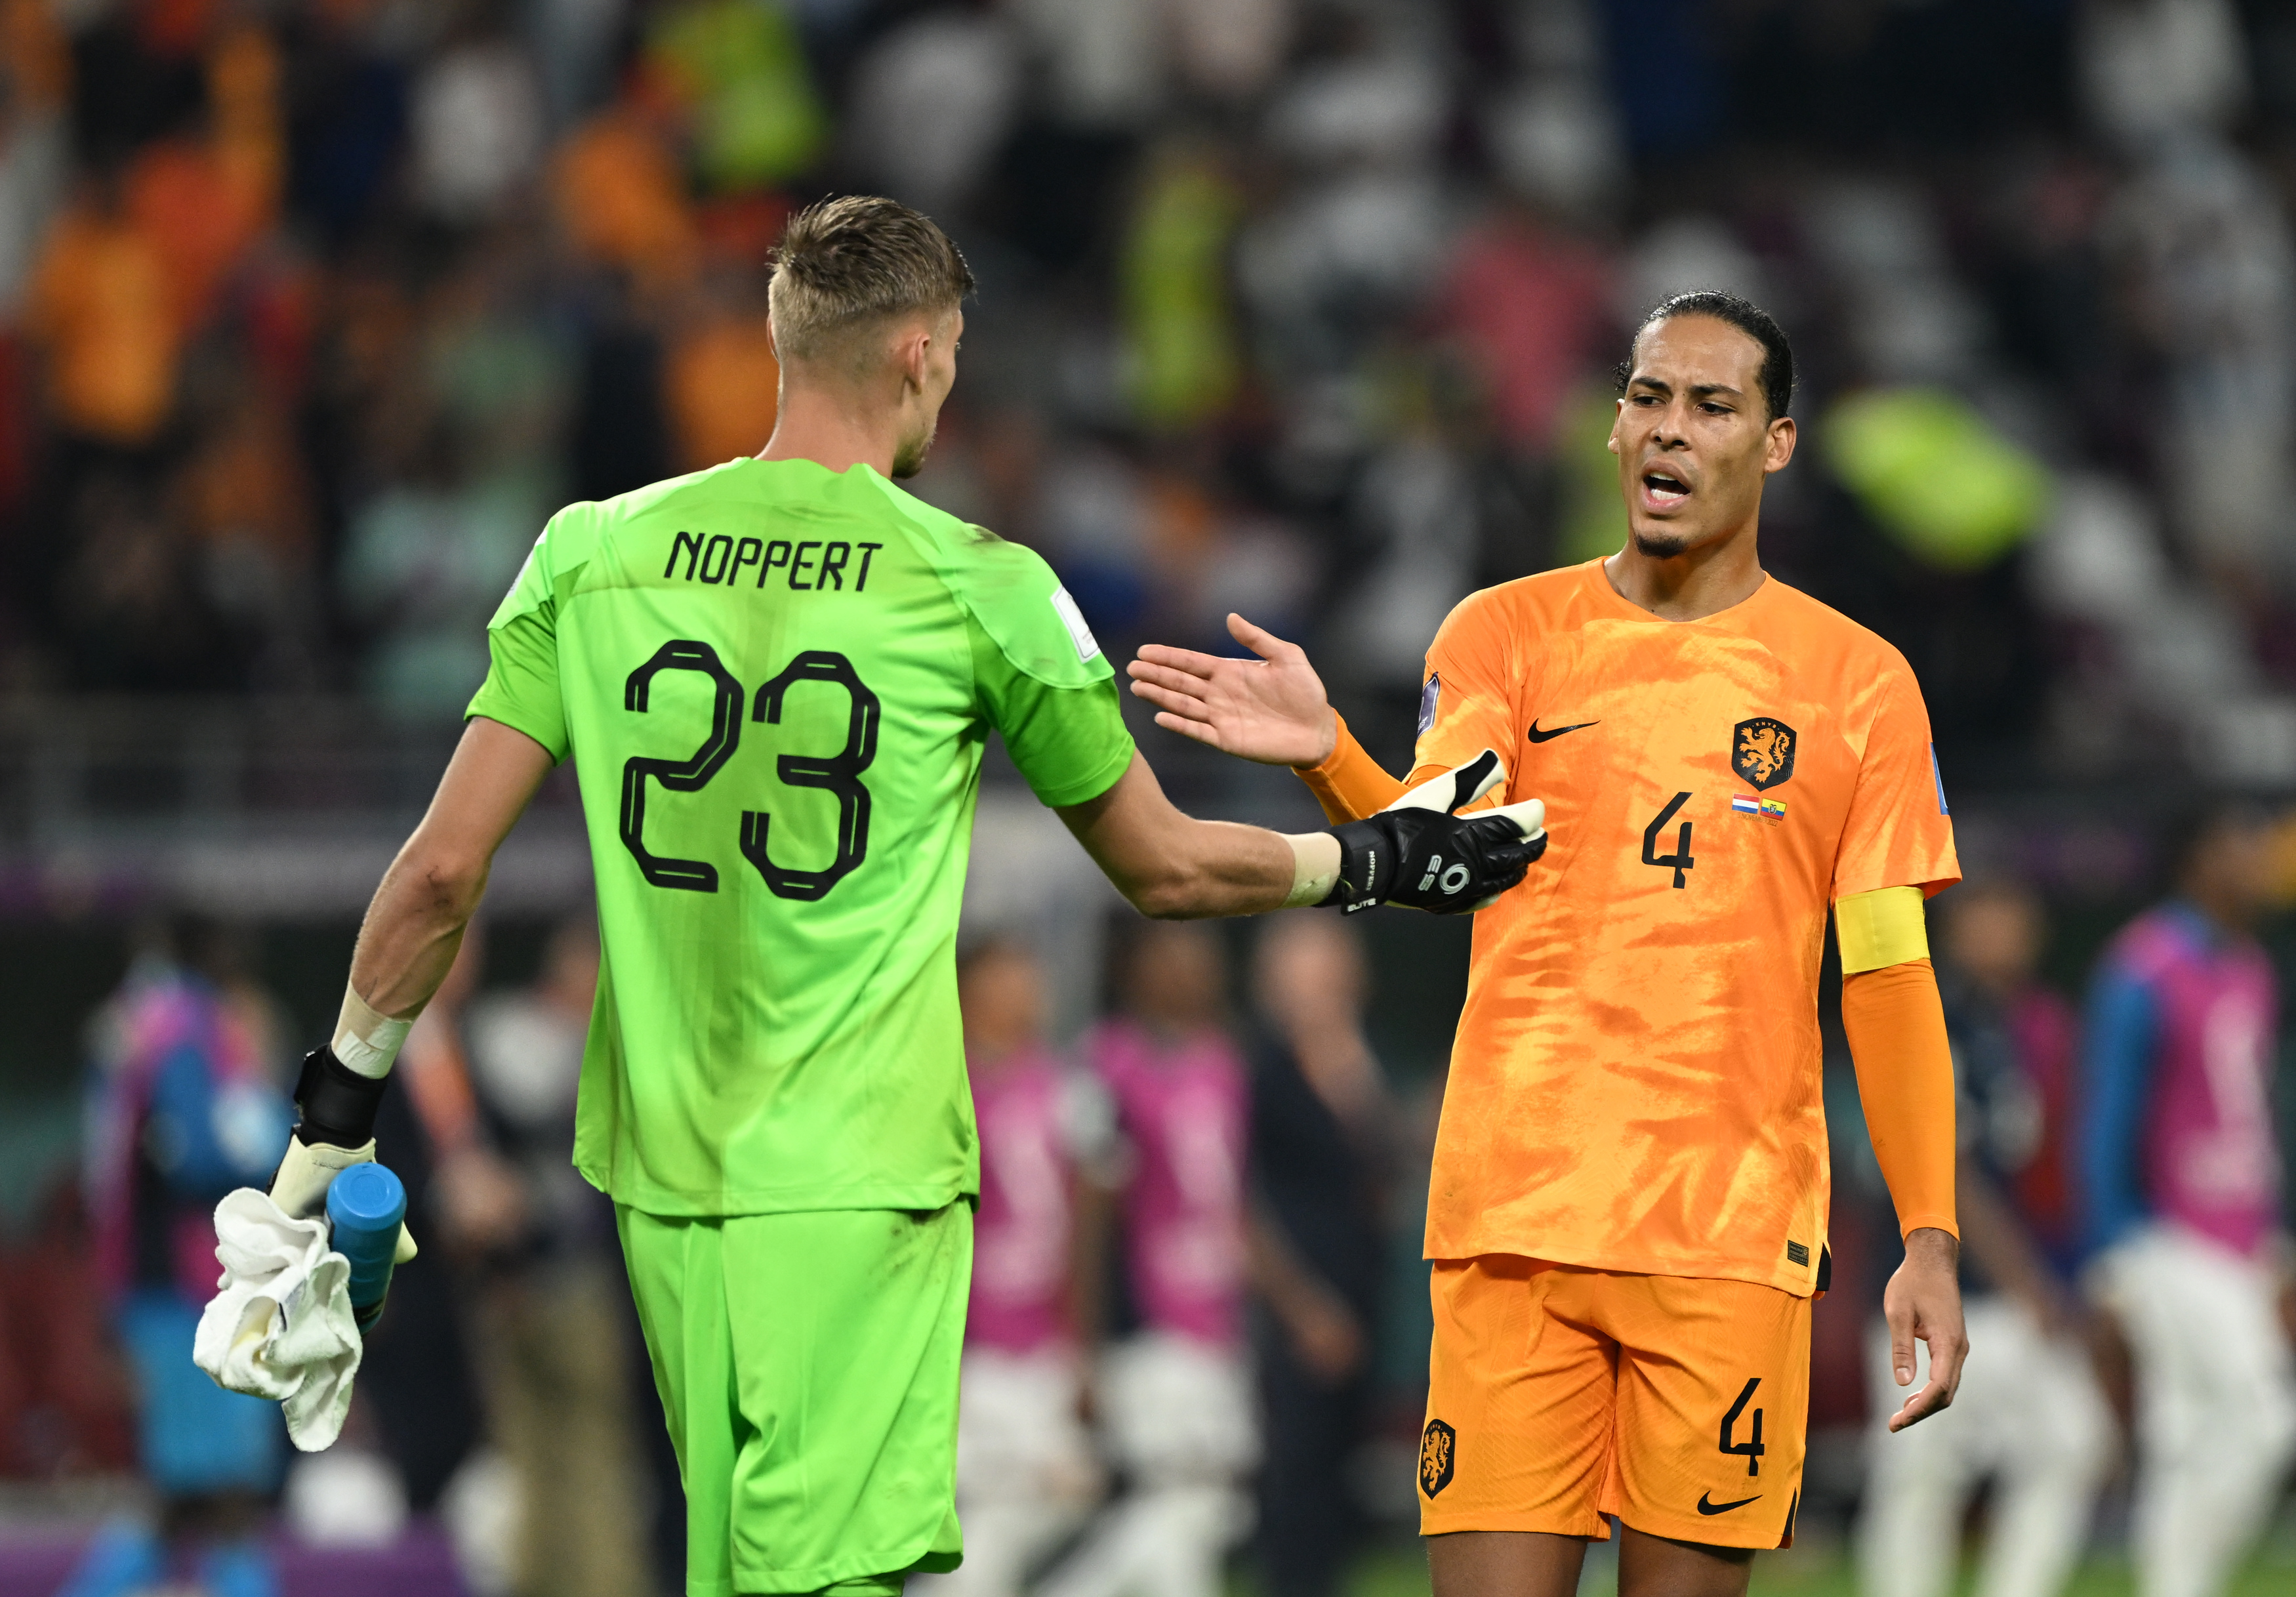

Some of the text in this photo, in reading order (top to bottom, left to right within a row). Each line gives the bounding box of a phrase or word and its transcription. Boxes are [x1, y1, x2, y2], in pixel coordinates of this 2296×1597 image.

[664, 531, 883, 592] NOPPERT
[619, 639, 881, 902] 23
[1366, 850, 1376, 891] NOPPERT
[1641, 792, 1694, 889] 4
[1347, 898, 1376, 912] ELITE
[1719, 1378, 1765, 1476] 4
